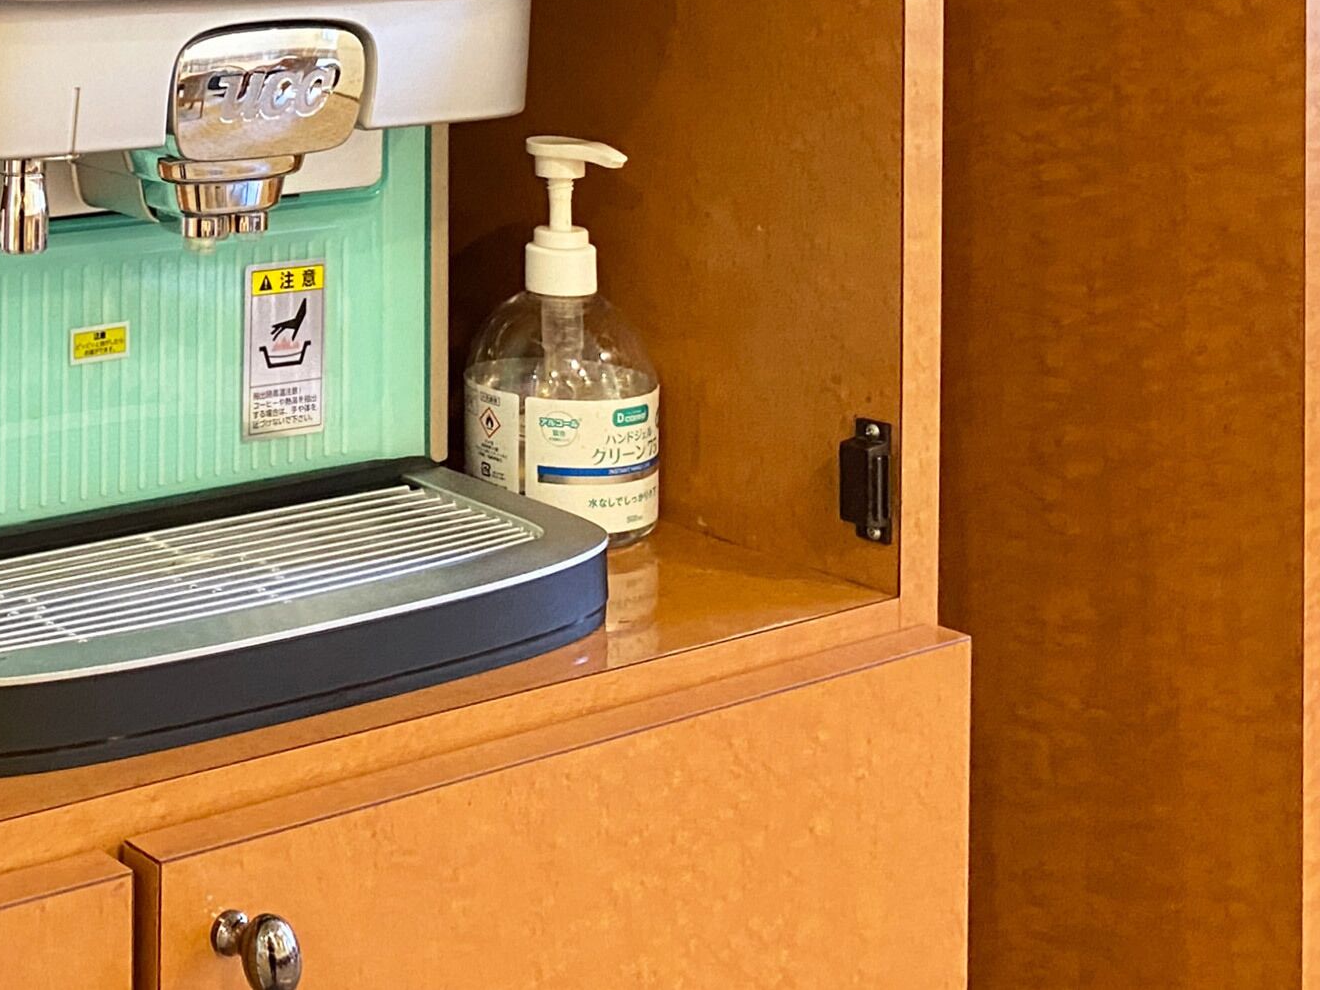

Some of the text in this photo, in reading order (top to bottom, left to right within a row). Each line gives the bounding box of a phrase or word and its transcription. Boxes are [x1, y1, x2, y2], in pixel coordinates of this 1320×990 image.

[279, 268, 317, 290] 注意
[539, 417, 580, 429] アルコール
[605, 426, 653, 445] ハンドジェル
